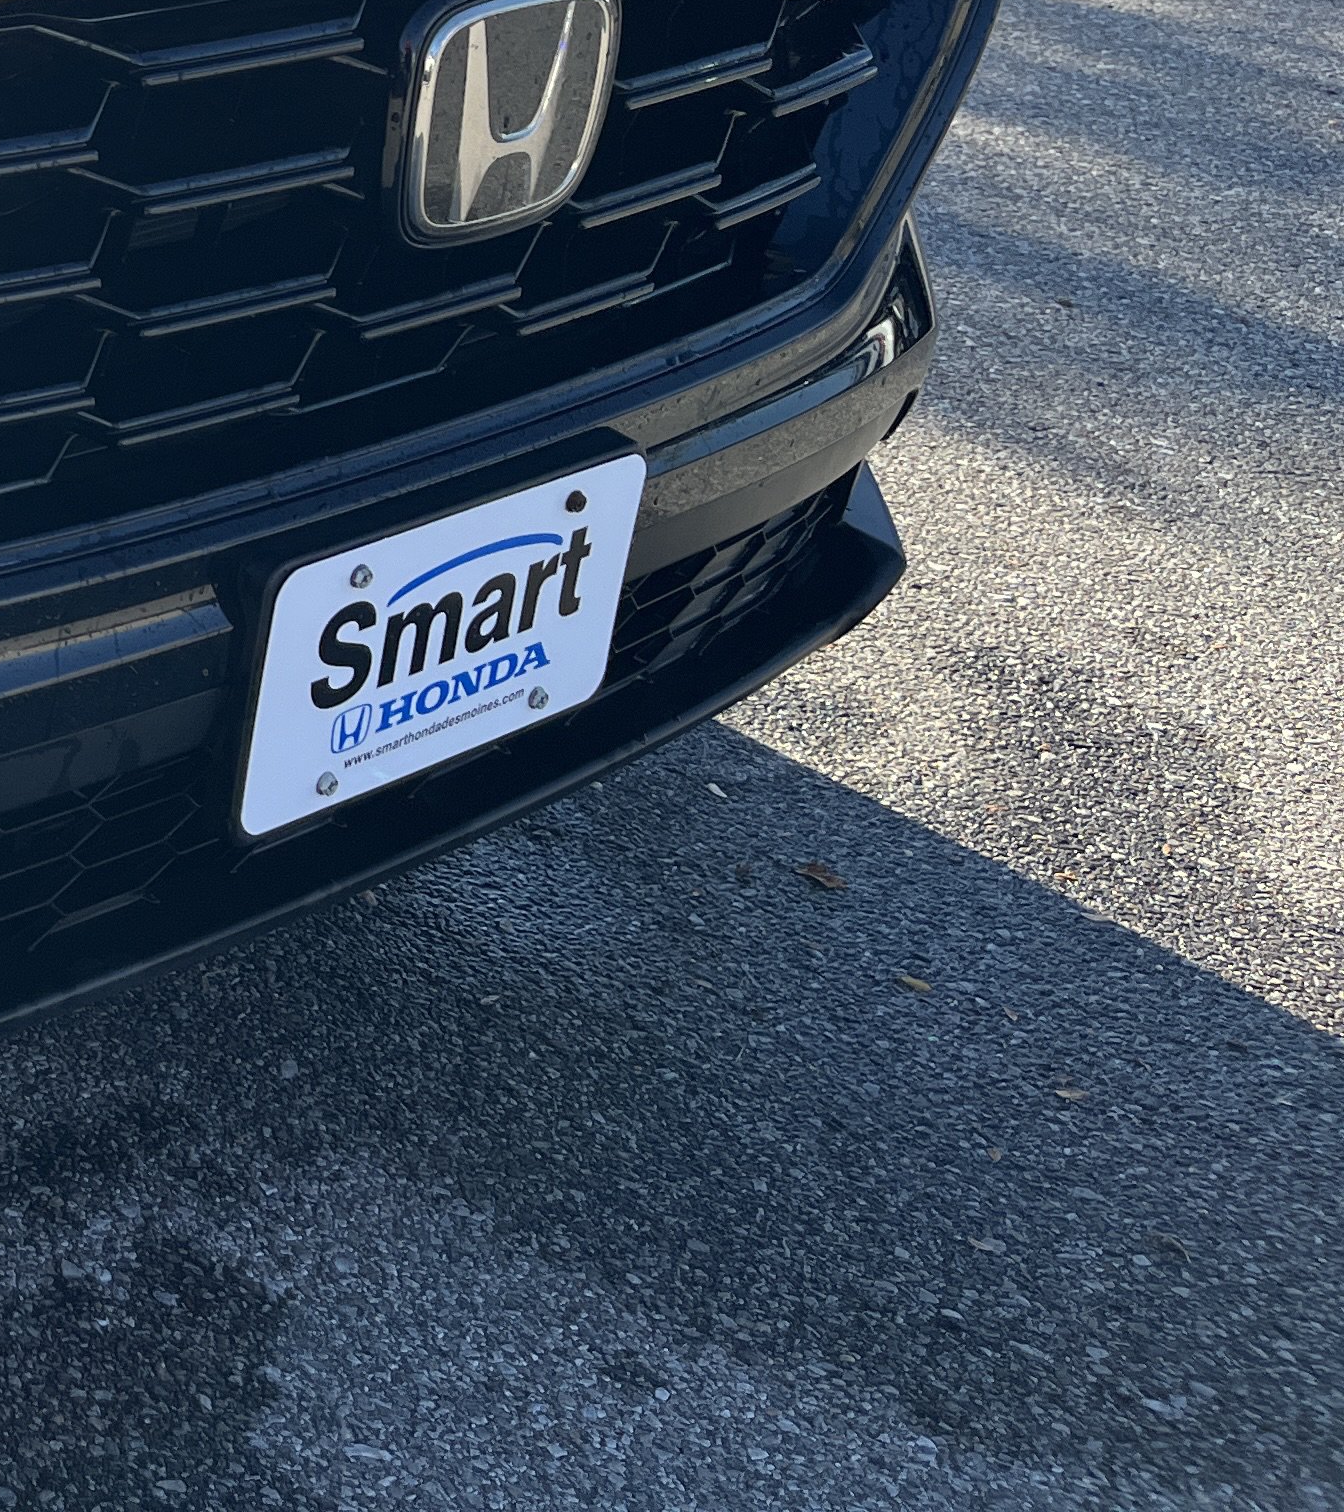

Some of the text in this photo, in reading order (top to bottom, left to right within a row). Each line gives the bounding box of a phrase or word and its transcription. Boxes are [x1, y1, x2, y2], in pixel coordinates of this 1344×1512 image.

[311, 526, 592, 709] Smart
[343, 688, 526, 769] www.smarthondadesmoines.com
[375, 641, 551, 733] HONDA
